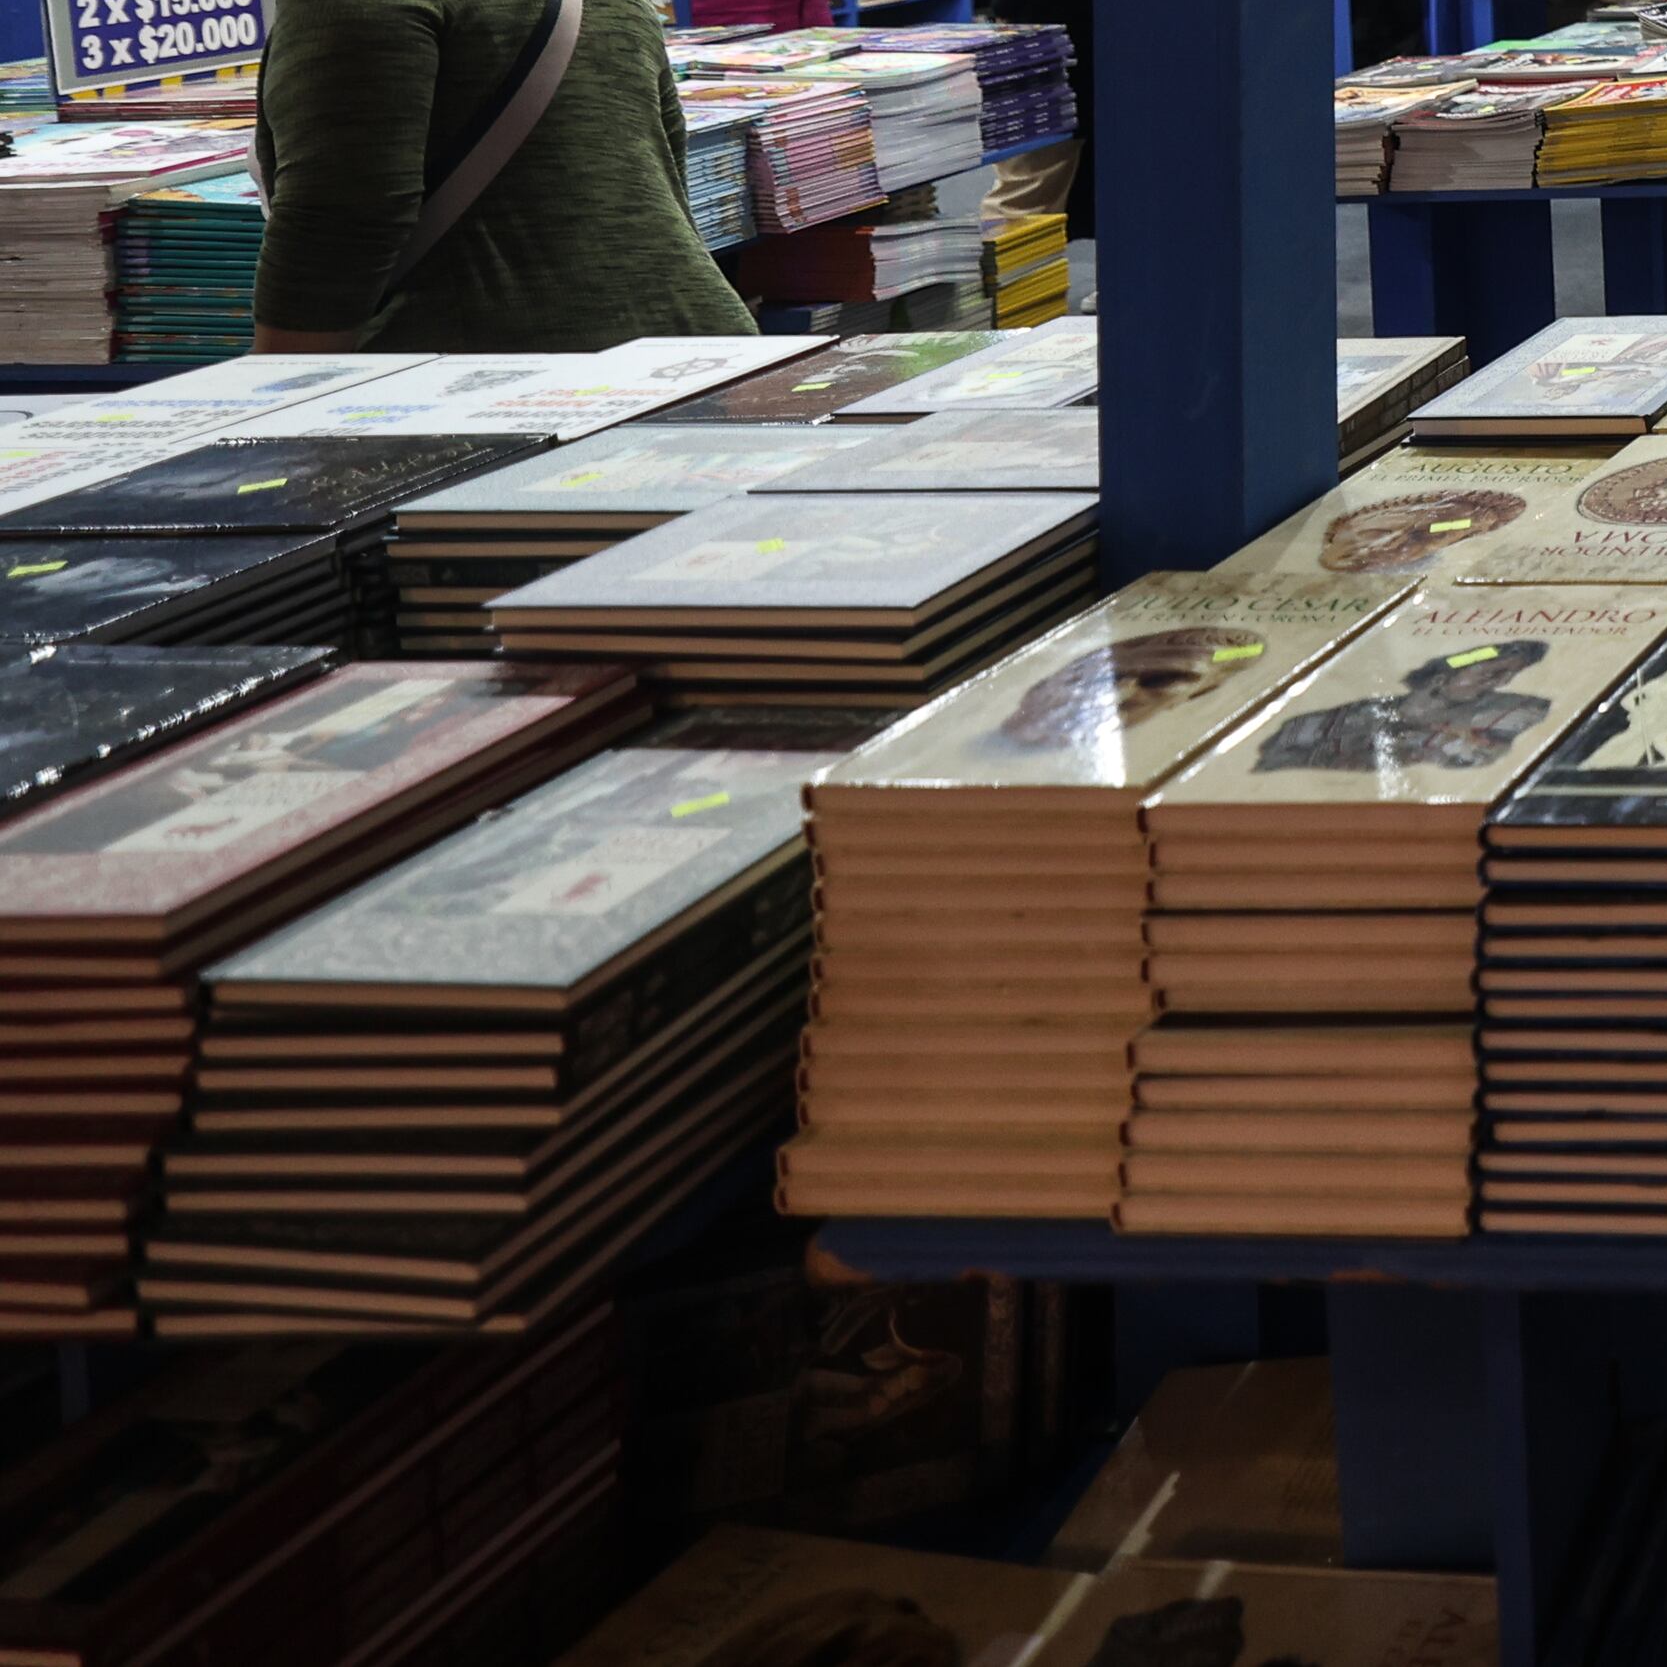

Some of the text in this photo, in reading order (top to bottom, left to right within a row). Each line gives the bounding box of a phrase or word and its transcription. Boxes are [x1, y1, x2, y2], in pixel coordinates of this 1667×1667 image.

[81, 13, 257, 70] 3 x $20.000
[1405, 463, 1574, 475] AUGUSTO
[1122, 597, 1241, 614] JULIO
[1412, 609, 1657, 625] ALEJANDRO
